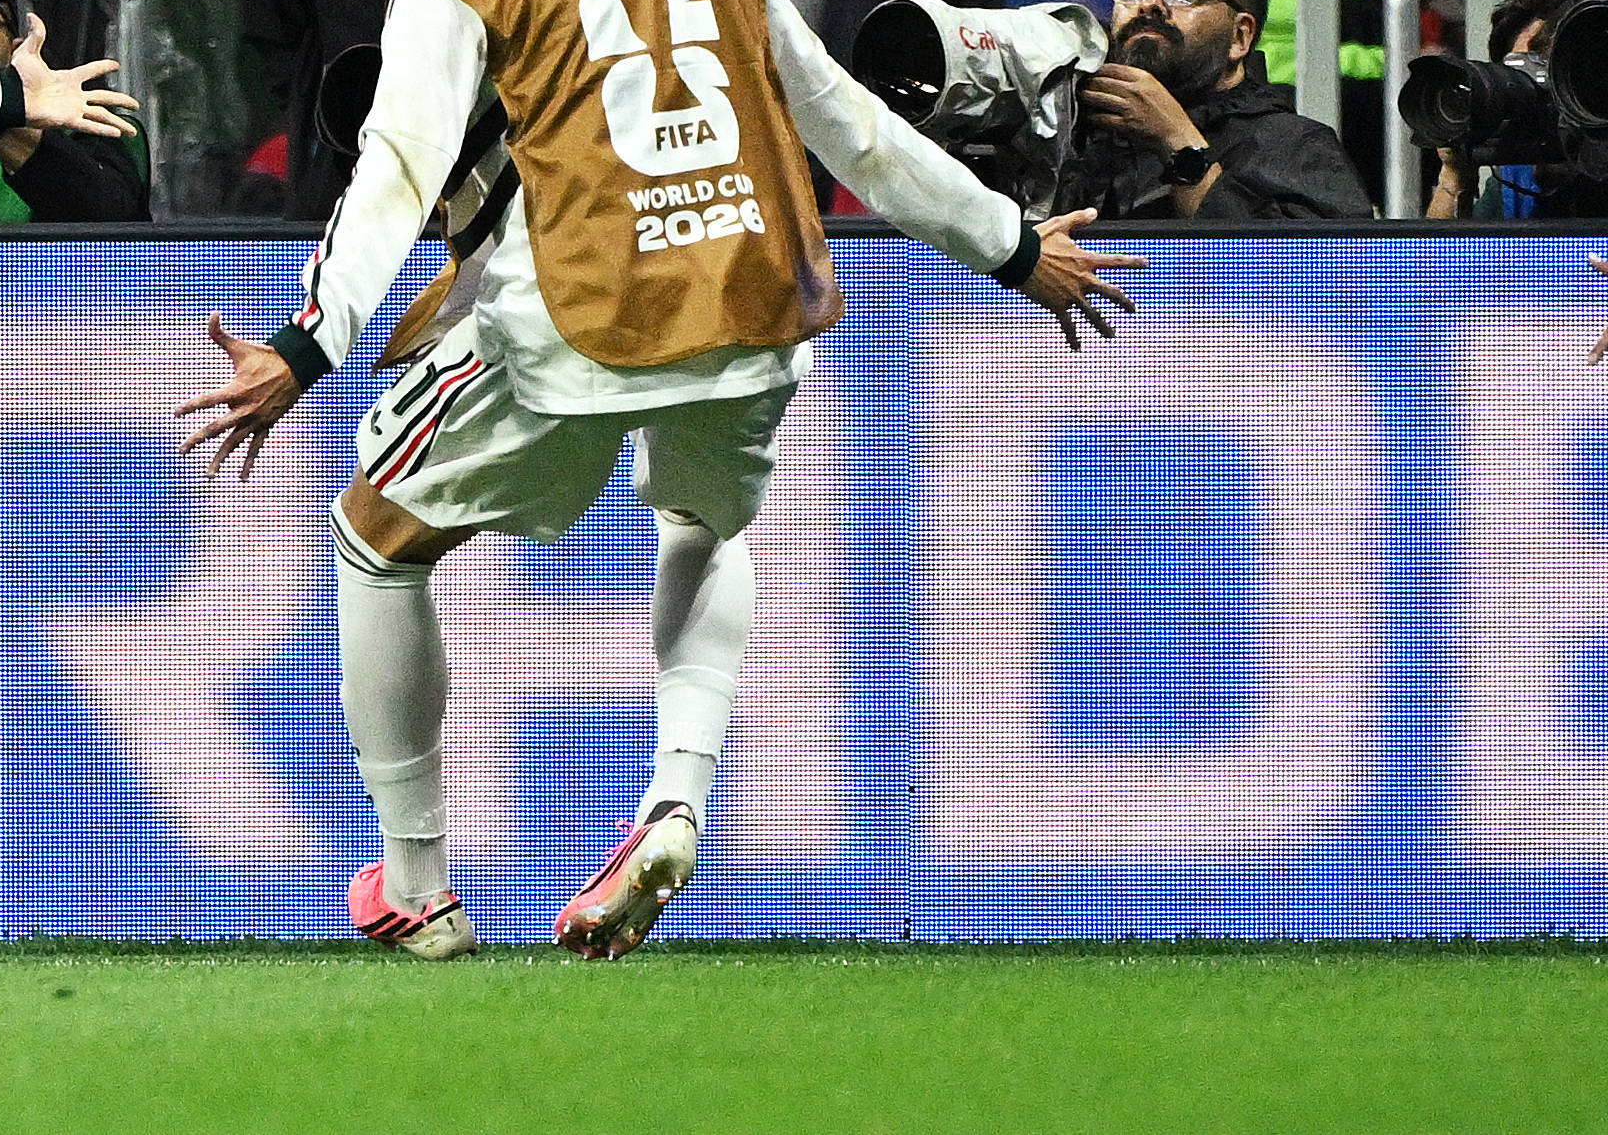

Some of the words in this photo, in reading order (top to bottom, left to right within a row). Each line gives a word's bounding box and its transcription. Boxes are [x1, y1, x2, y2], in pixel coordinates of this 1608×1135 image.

[655, 119, 717, 152] FIFA
[627, 179, 715, 212] WORLD
[635, 198, 766, 253] 2026
